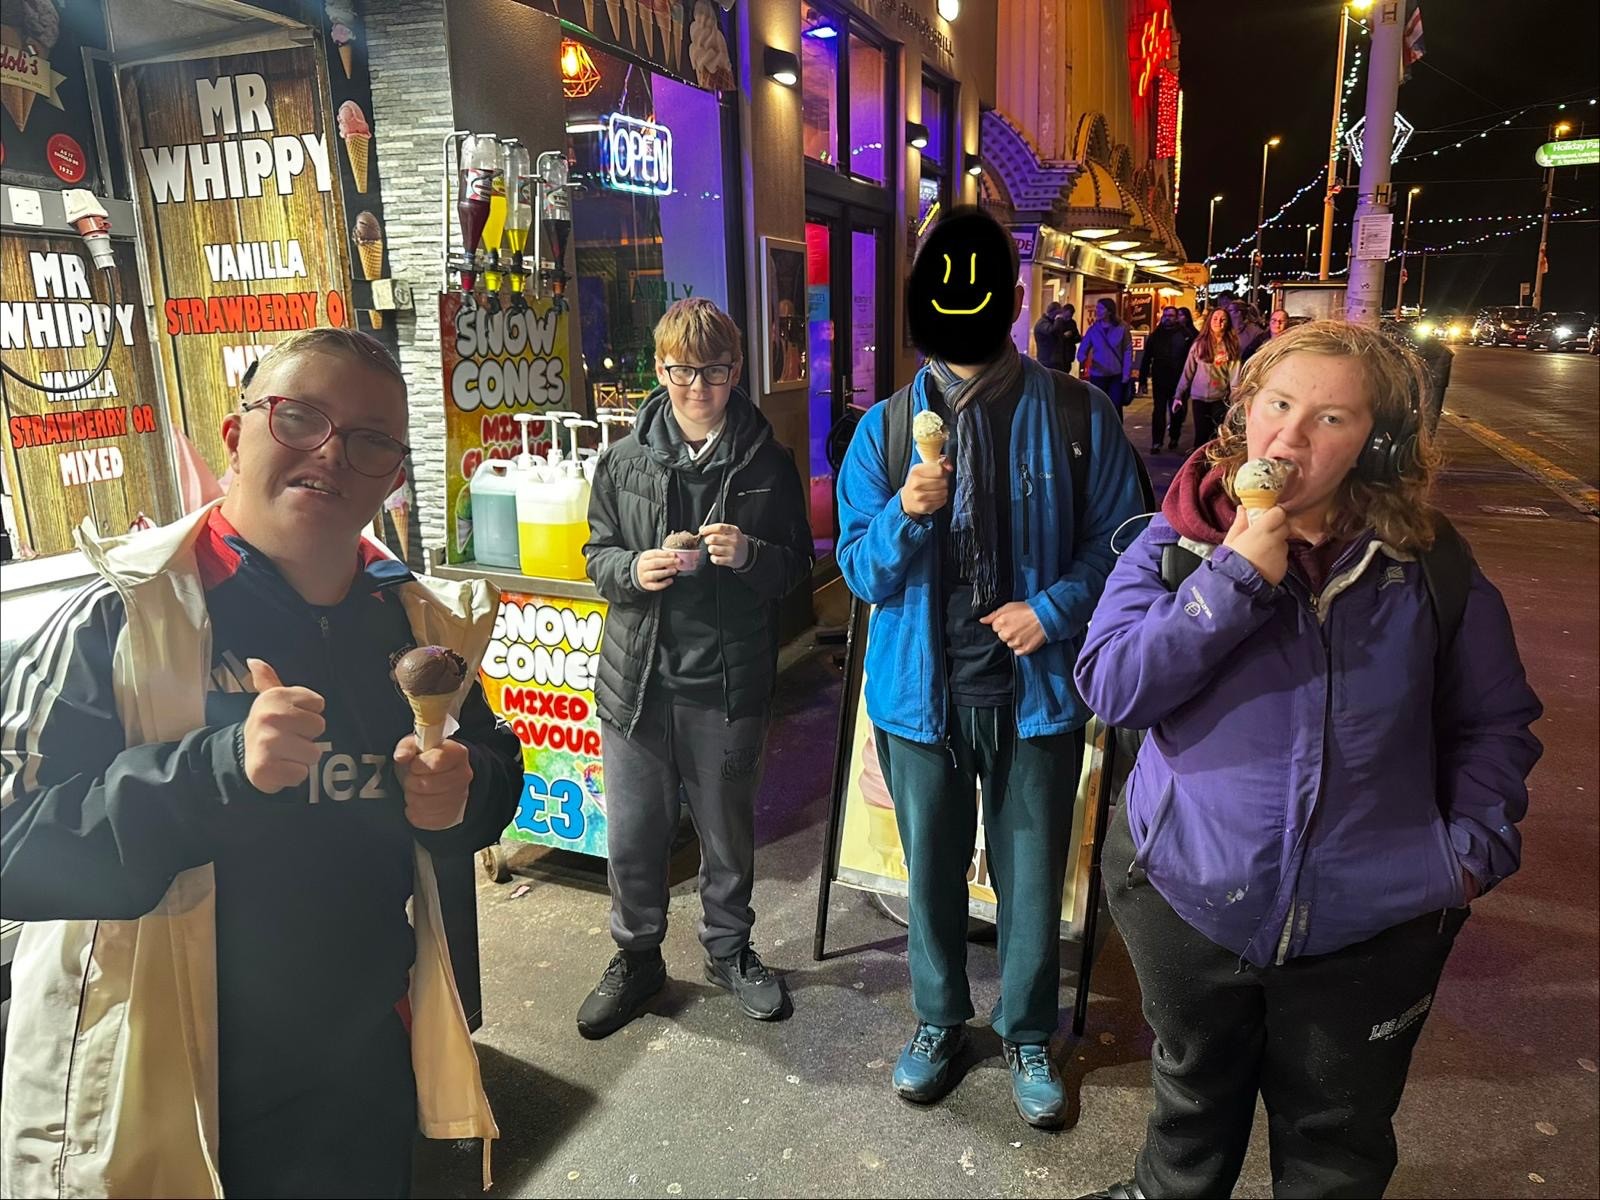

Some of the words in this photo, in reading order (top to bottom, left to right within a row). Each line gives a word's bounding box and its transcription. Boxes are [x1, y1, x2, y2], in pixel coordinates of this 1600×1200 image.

[196, 73, 274, 136] MR
[140, 132, 332, 204] WHIPPY
[614, 128, 668, 184] OPEN
[1376, 185, 1389, 203] H
[29, 251, 92, 299] MR
[203, 239, 308, 282] VANILLA
[0, 301, 135, 349] WHIPPY
[165, 291, 318, 336] STRAWBERRY
[326, 290, 346, 328] O
[455, 306, 558, 358] SNOW
[40, 368, 119, 403] VANILLA
[451, 356, 565, 412] CONES
[9, 406, 127, 449] STRAWBERRY
[132, 404, 156, 433] OR
[481, 413, 546, 447] MIXD
[58, 446, 124, 486] MIXED
[504, 687, 588, 721] MIXED
[512, 719, 602, 757] AVOUR
[308, 741, 388, 804] Tez
[515, 773, 585, 840] £3
